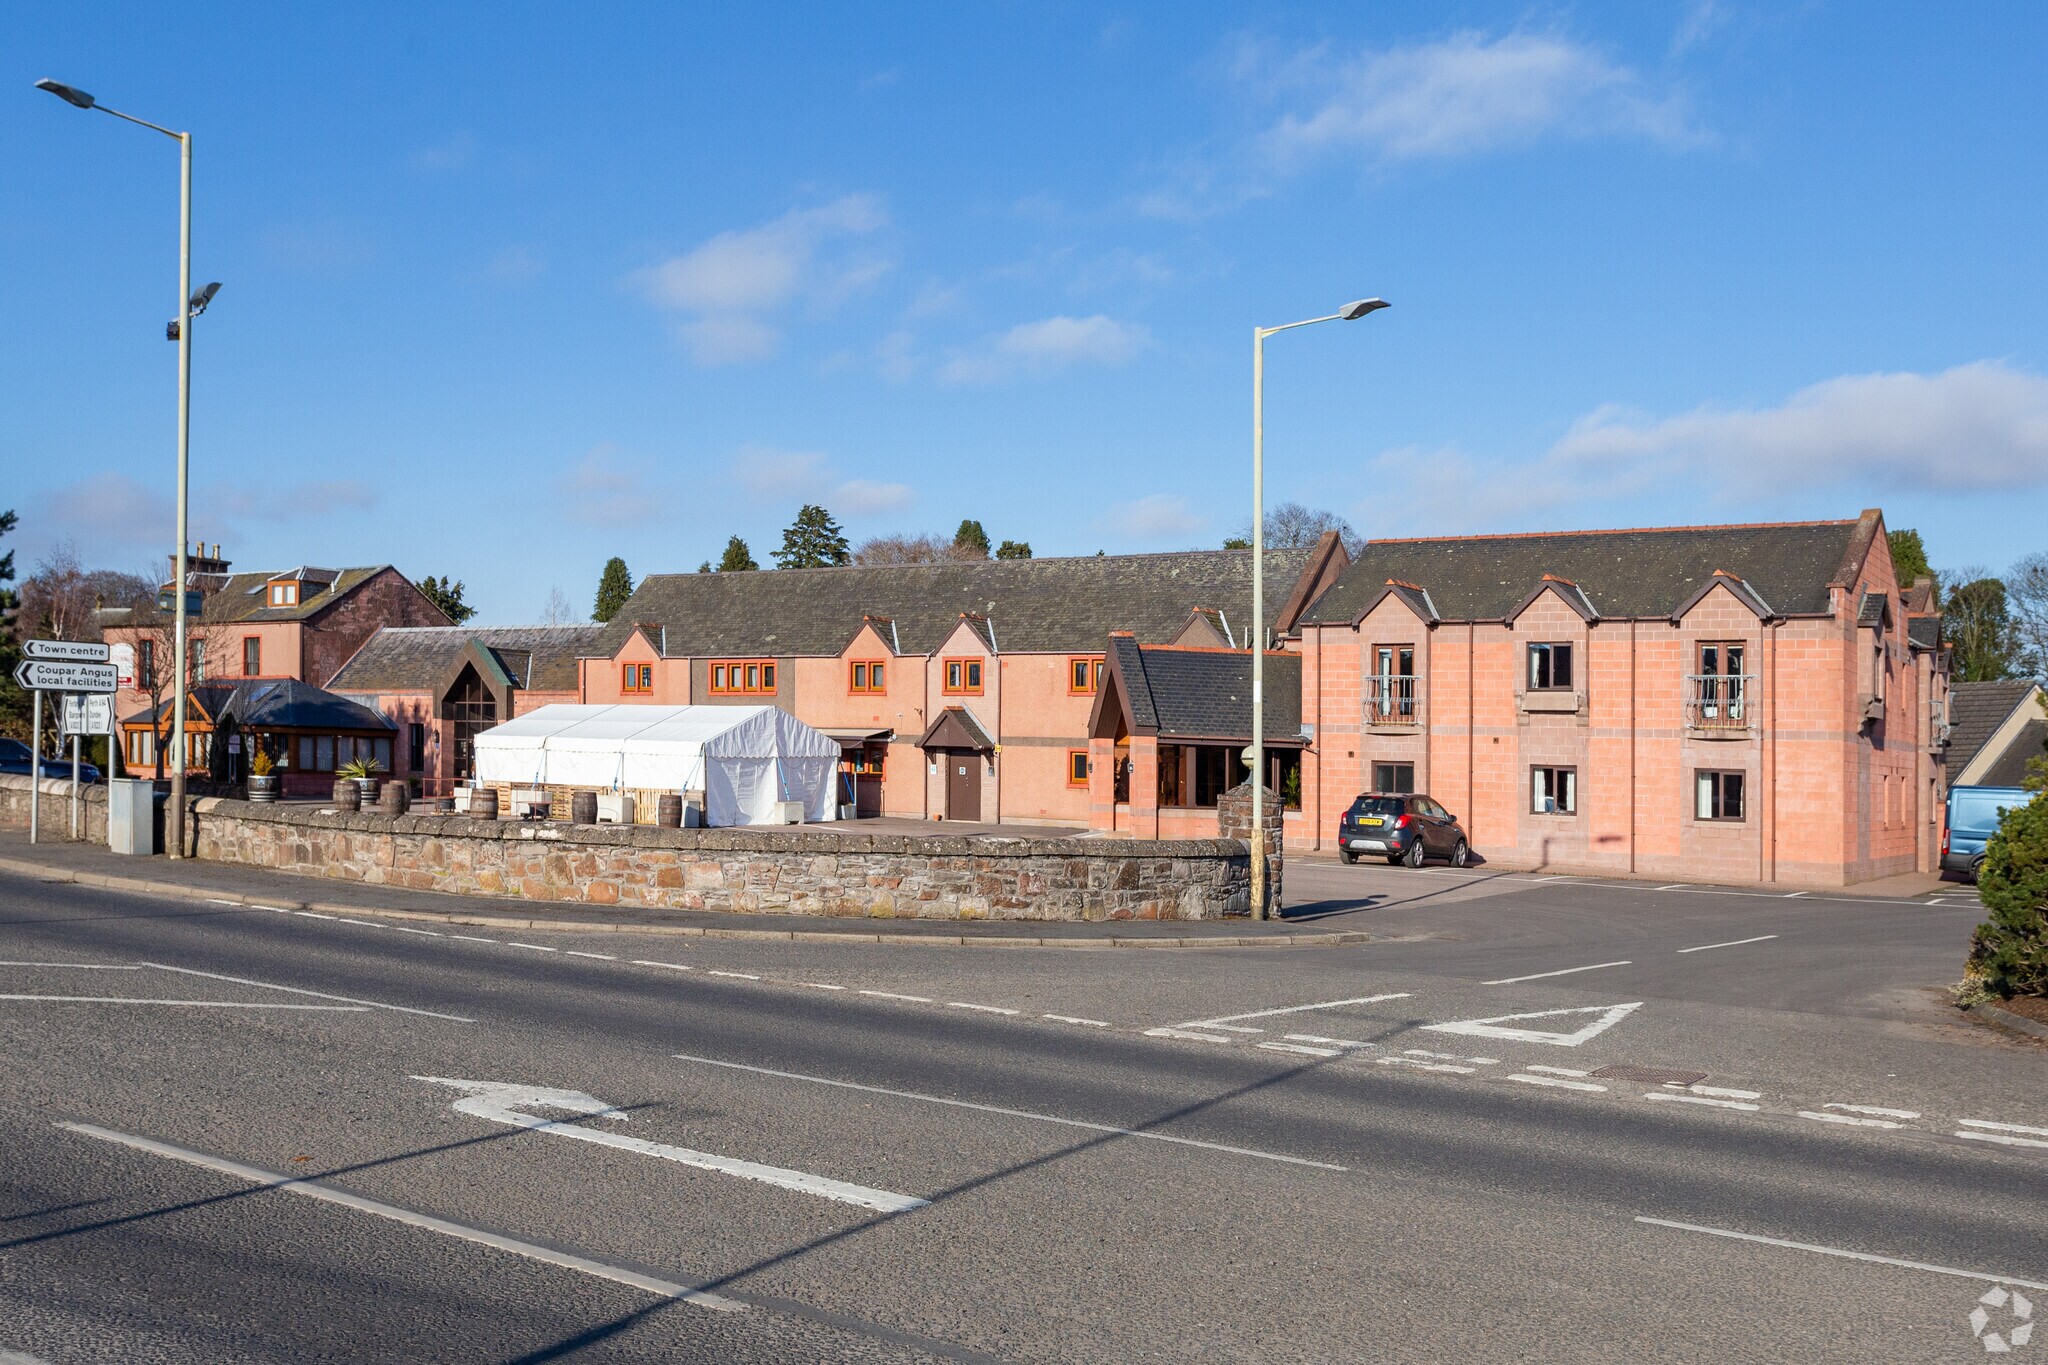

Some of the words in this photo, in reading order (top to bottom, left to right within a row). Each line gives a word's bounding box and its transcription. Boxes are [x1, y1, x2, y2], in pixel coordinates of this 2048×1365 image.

[39, 644, 66, 654] Town
[70, 647, 105, 656] centre
[37, 665, 76, 676] Coupar
[80, 667, 113, 678] Angus
[37, 676, 63, 685] local
[67, 677, 112, 687] facilities
